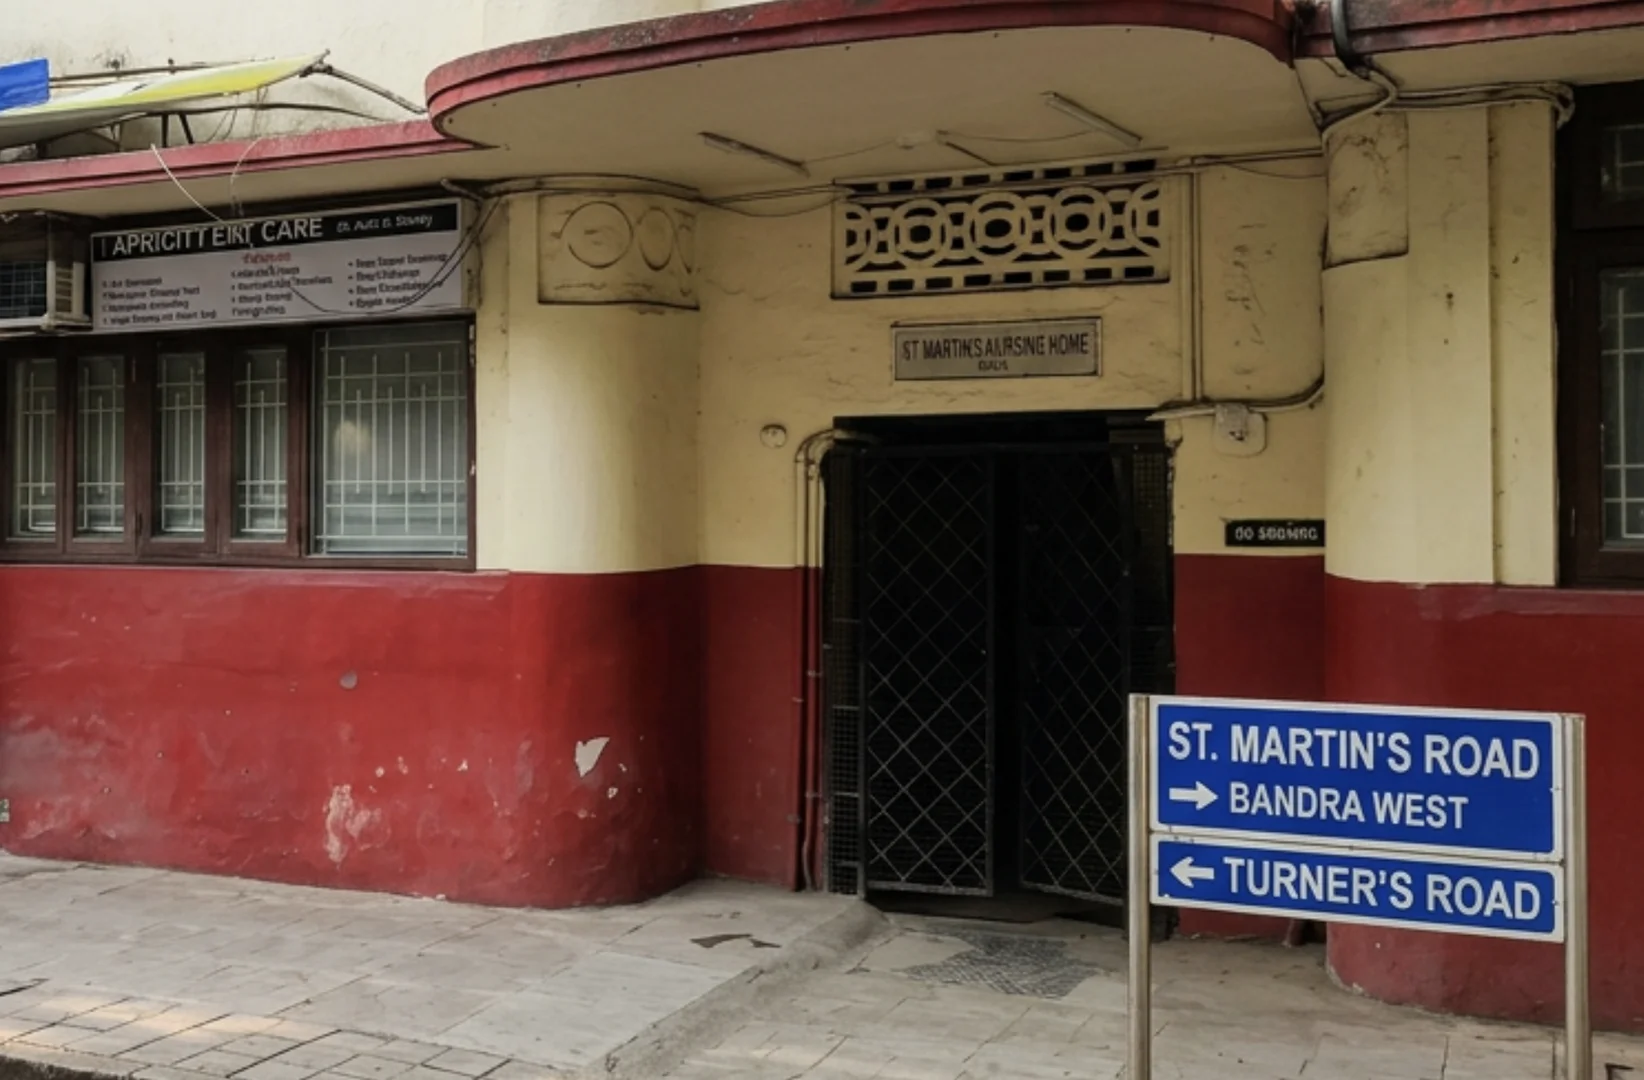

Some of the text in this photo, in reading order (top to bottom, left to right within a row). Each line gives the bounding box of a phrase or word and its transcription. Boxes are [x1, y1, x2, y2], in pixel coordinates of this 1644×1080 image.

[261, 217, 324, 242] CARE
[1048, 332, 1089, 355] HOME
[1168, 721, 1539, 780] ST. MARTIN'S ROAD
[1229, 781, 1469, 829] BANDRA WEST
[1223, 857, 1540, 920] TURNER'S ROAD
